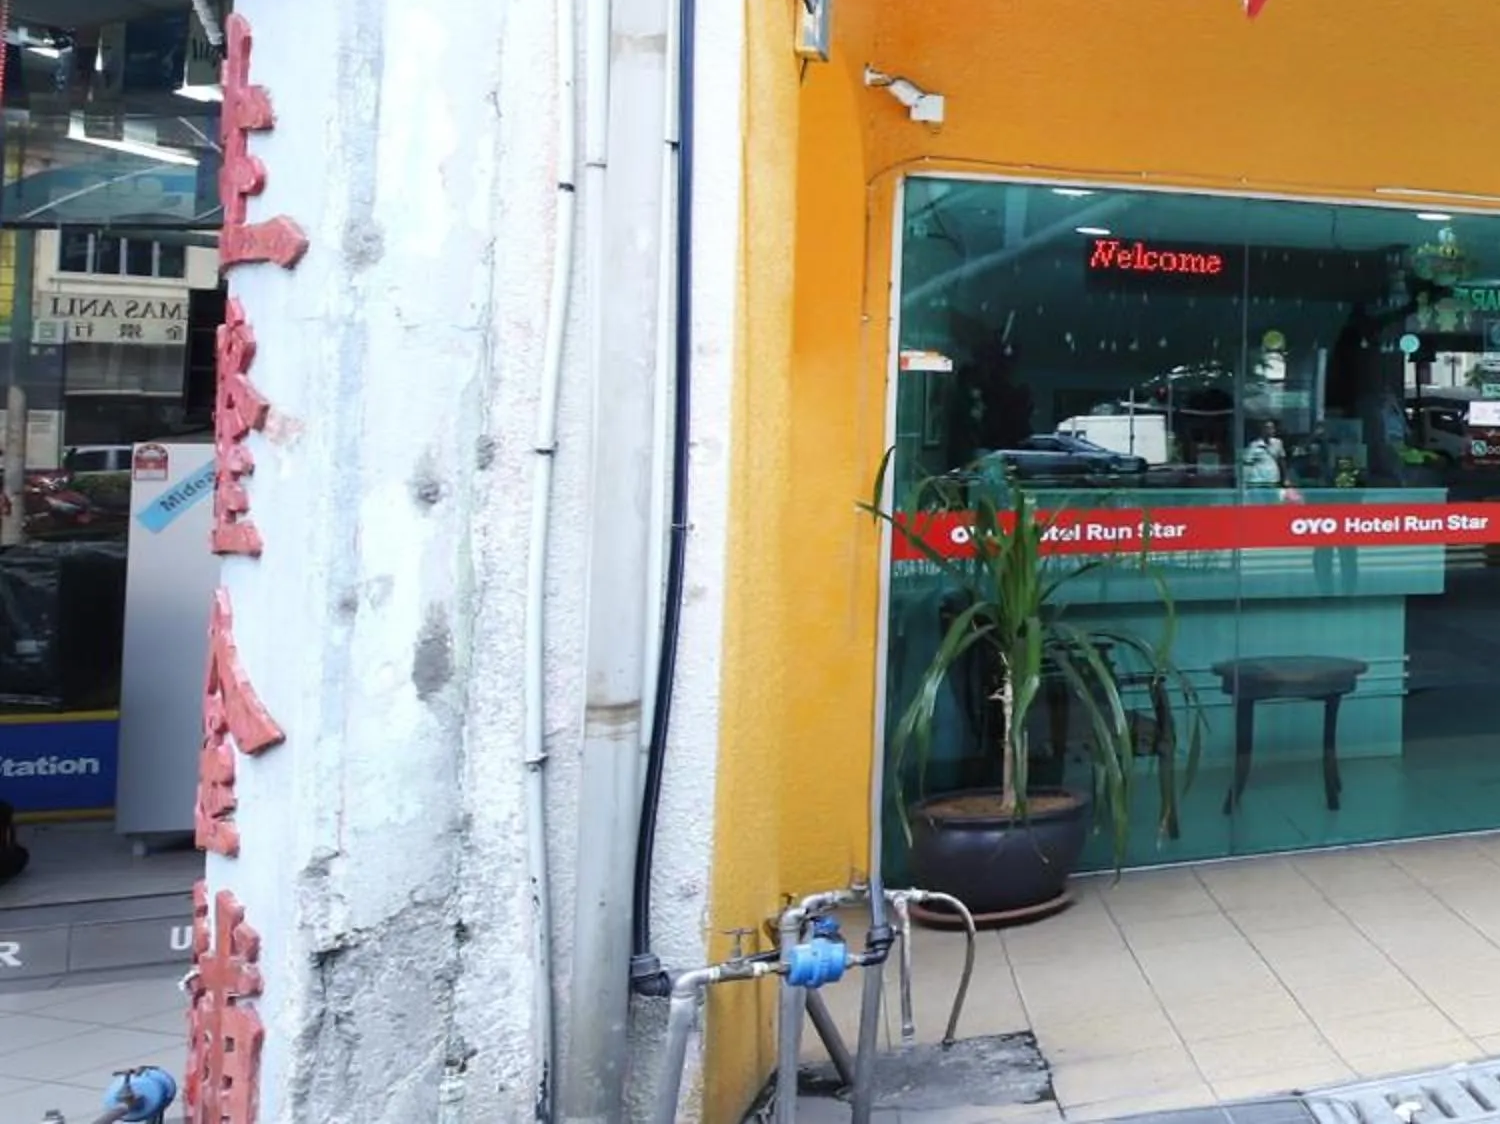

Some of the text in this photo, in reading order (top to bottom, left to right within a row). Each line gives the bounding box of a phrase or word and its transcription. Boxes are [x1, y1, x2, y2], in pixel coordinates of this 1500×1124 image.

[1090, 239, 1221, 273] Welcome
[1086, 523, 1132, 541] Run
[1290, 514, 1489, 535] OYO Hotel Run Star
